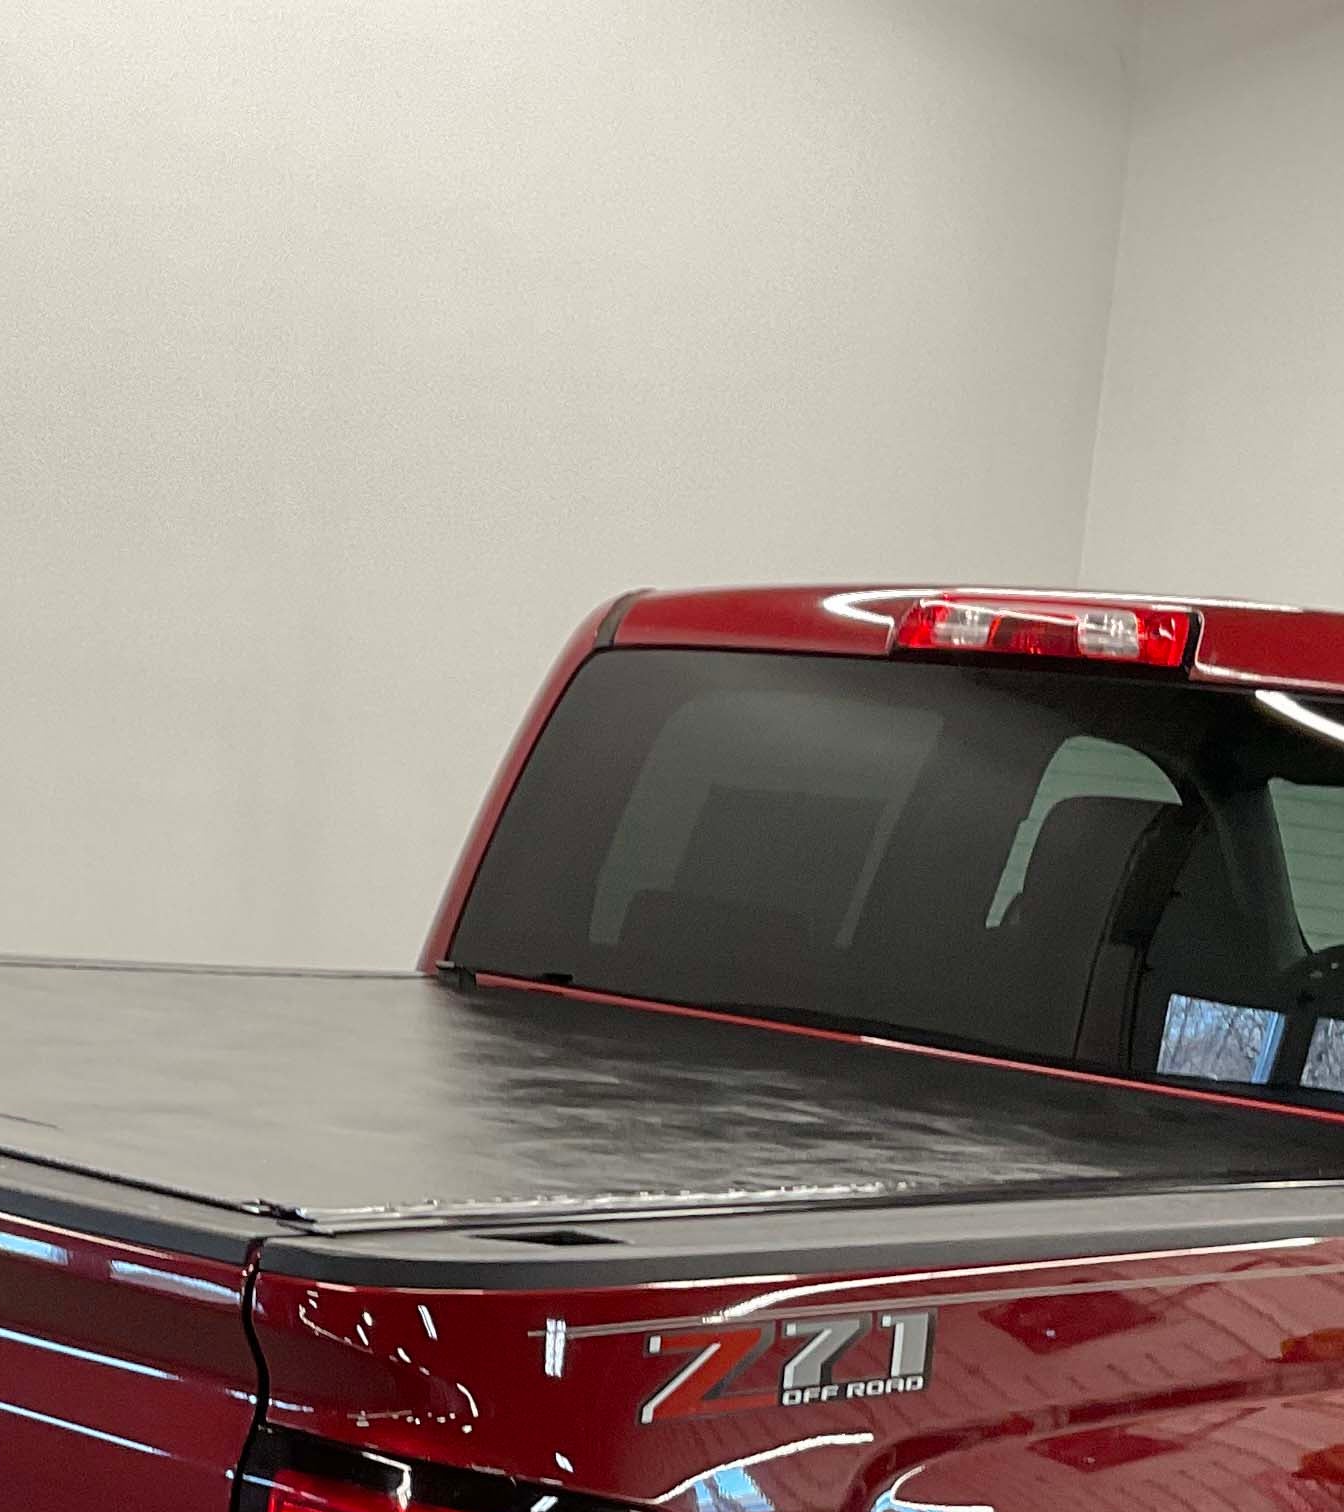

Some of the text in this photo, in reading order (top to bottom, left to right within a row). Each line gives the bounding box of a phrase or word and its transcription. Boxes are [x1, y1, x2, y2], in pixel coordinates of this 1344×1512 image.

[638, 1311, 935, 1424] Z71
[781, 1375, 925, 1406] OFF ROAD
